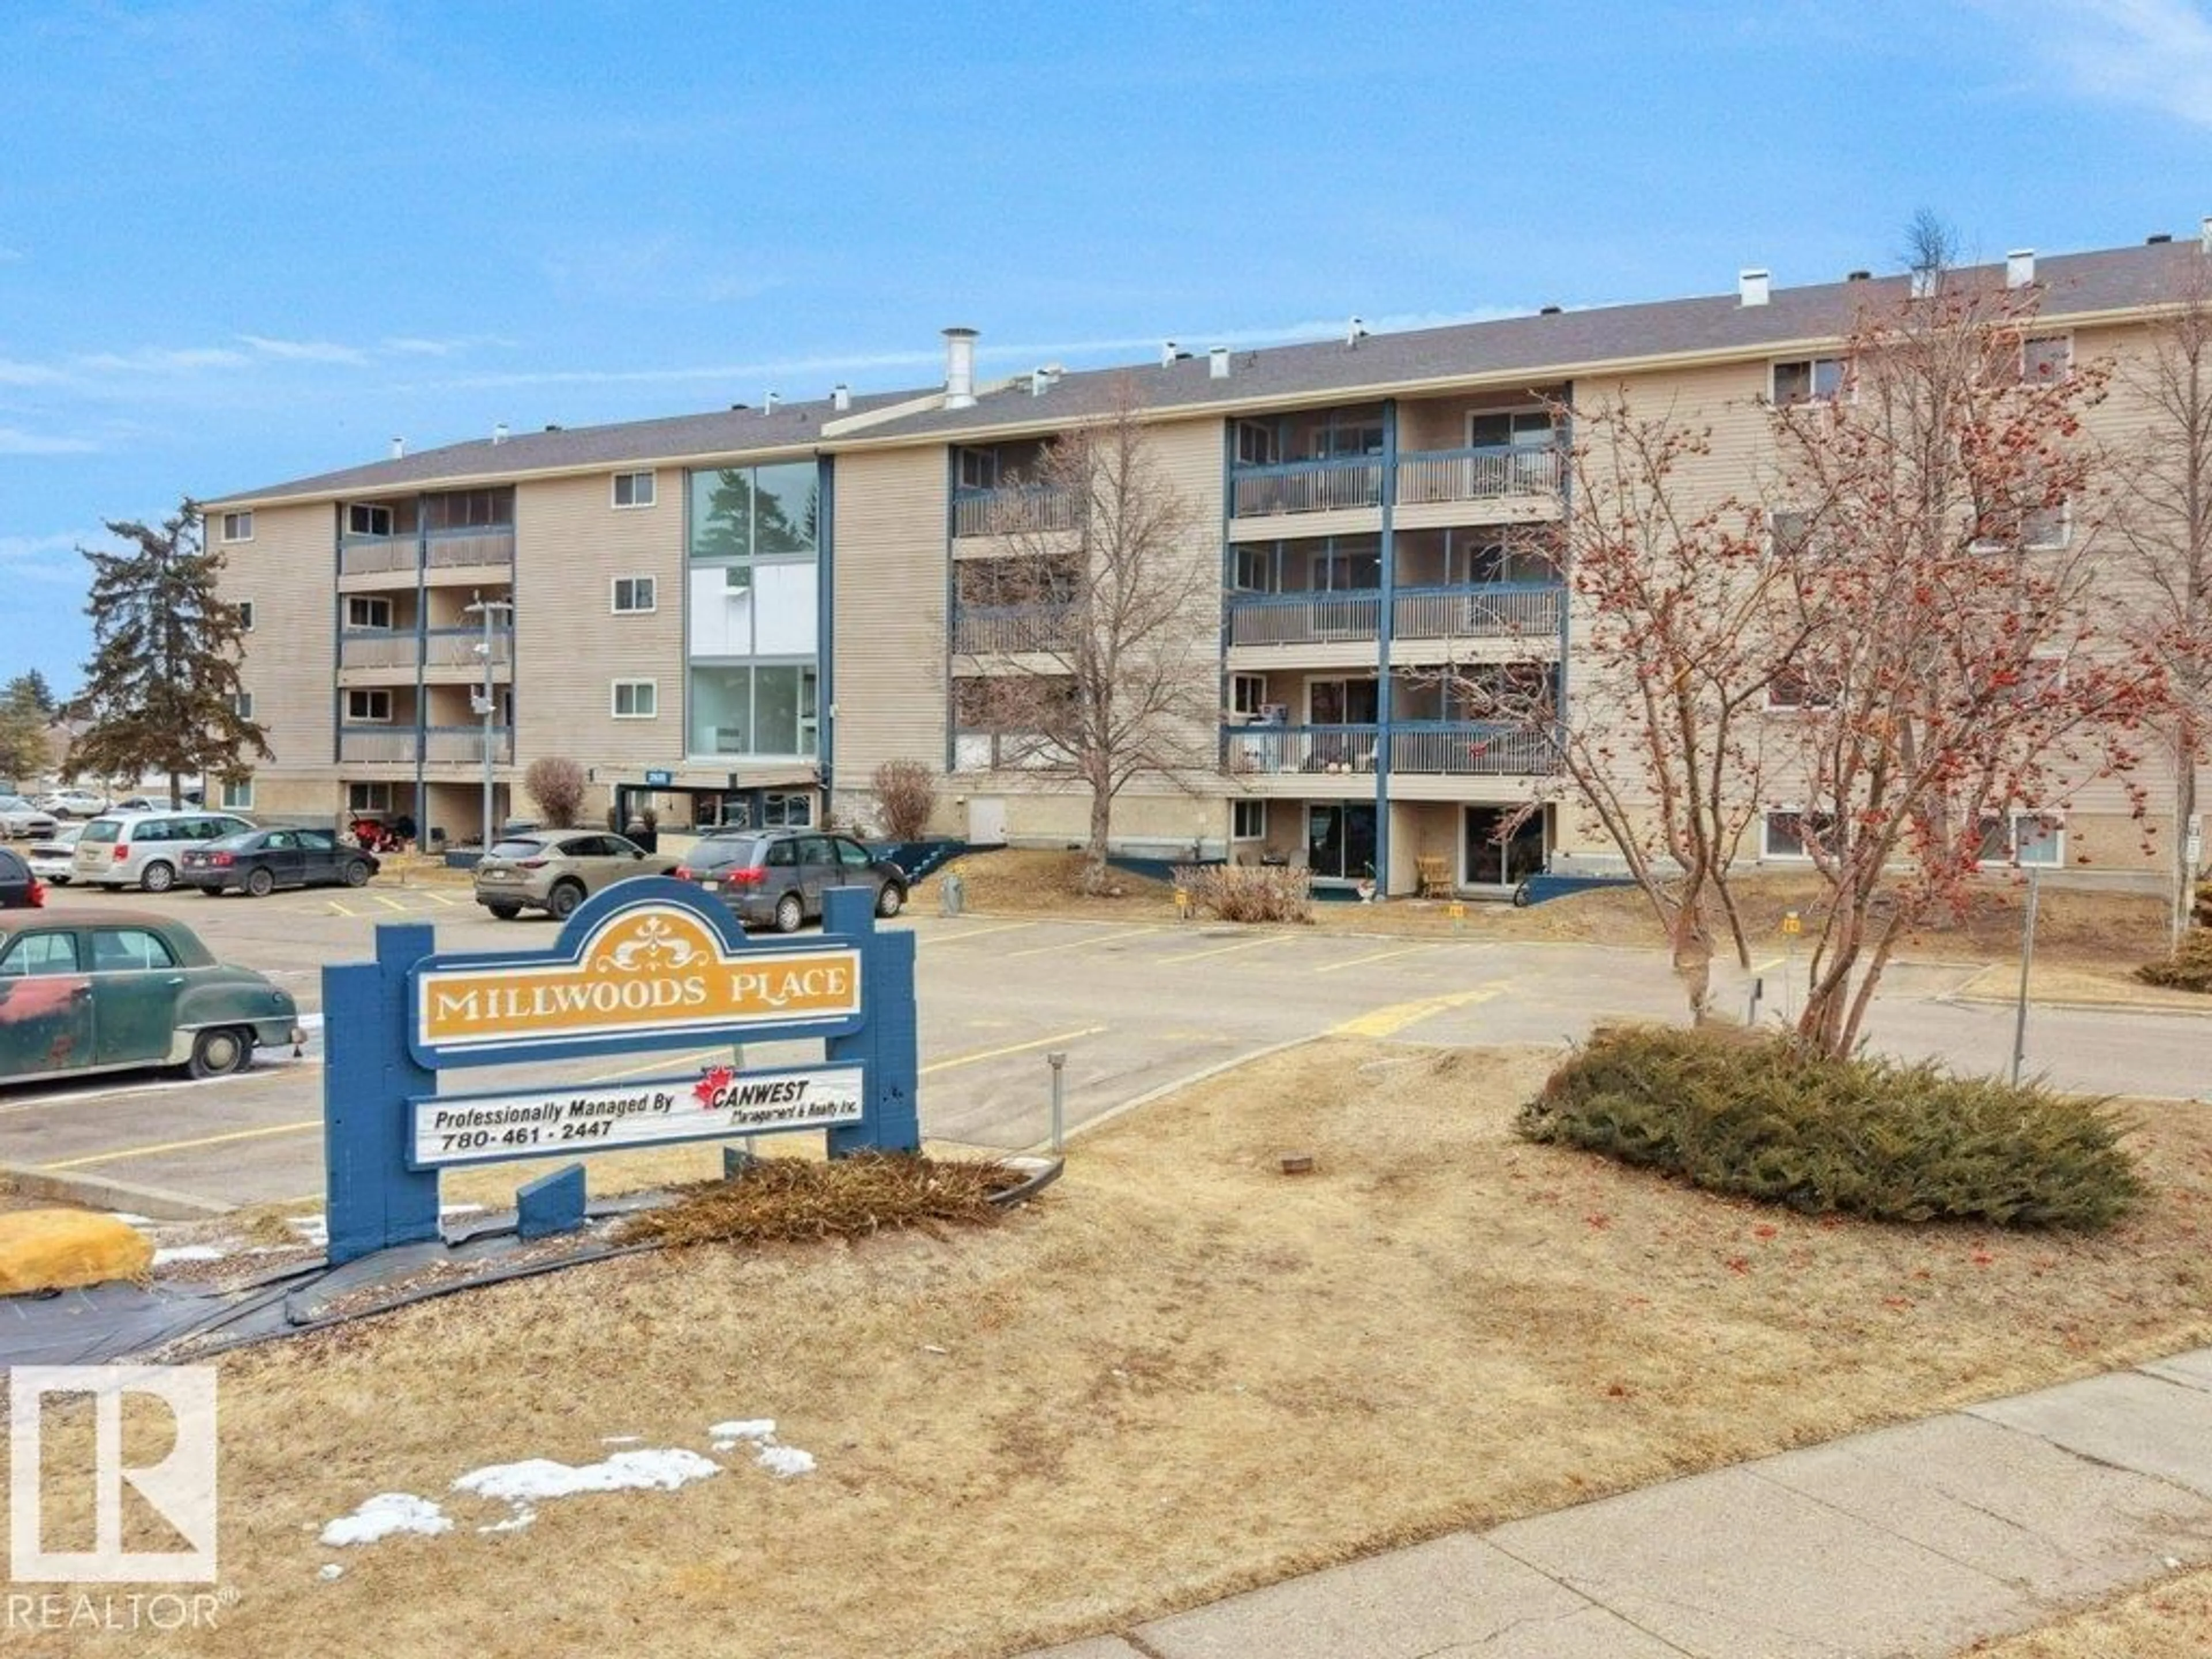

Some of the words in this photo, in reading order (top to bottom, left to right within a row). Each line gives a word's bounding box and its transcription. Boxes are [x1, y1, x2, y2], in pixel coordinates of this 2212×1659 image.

[436, 976, 707, 1021] MILLWOODS
[730, 967, 847, 1006] PLACE
[435, 1103, 564, 1128] Professionally
[568, 1095, 648, 1118] Managed
[653, 1092, 675, 1112] By
[713, 1080, 809, 1108] CANWEST
